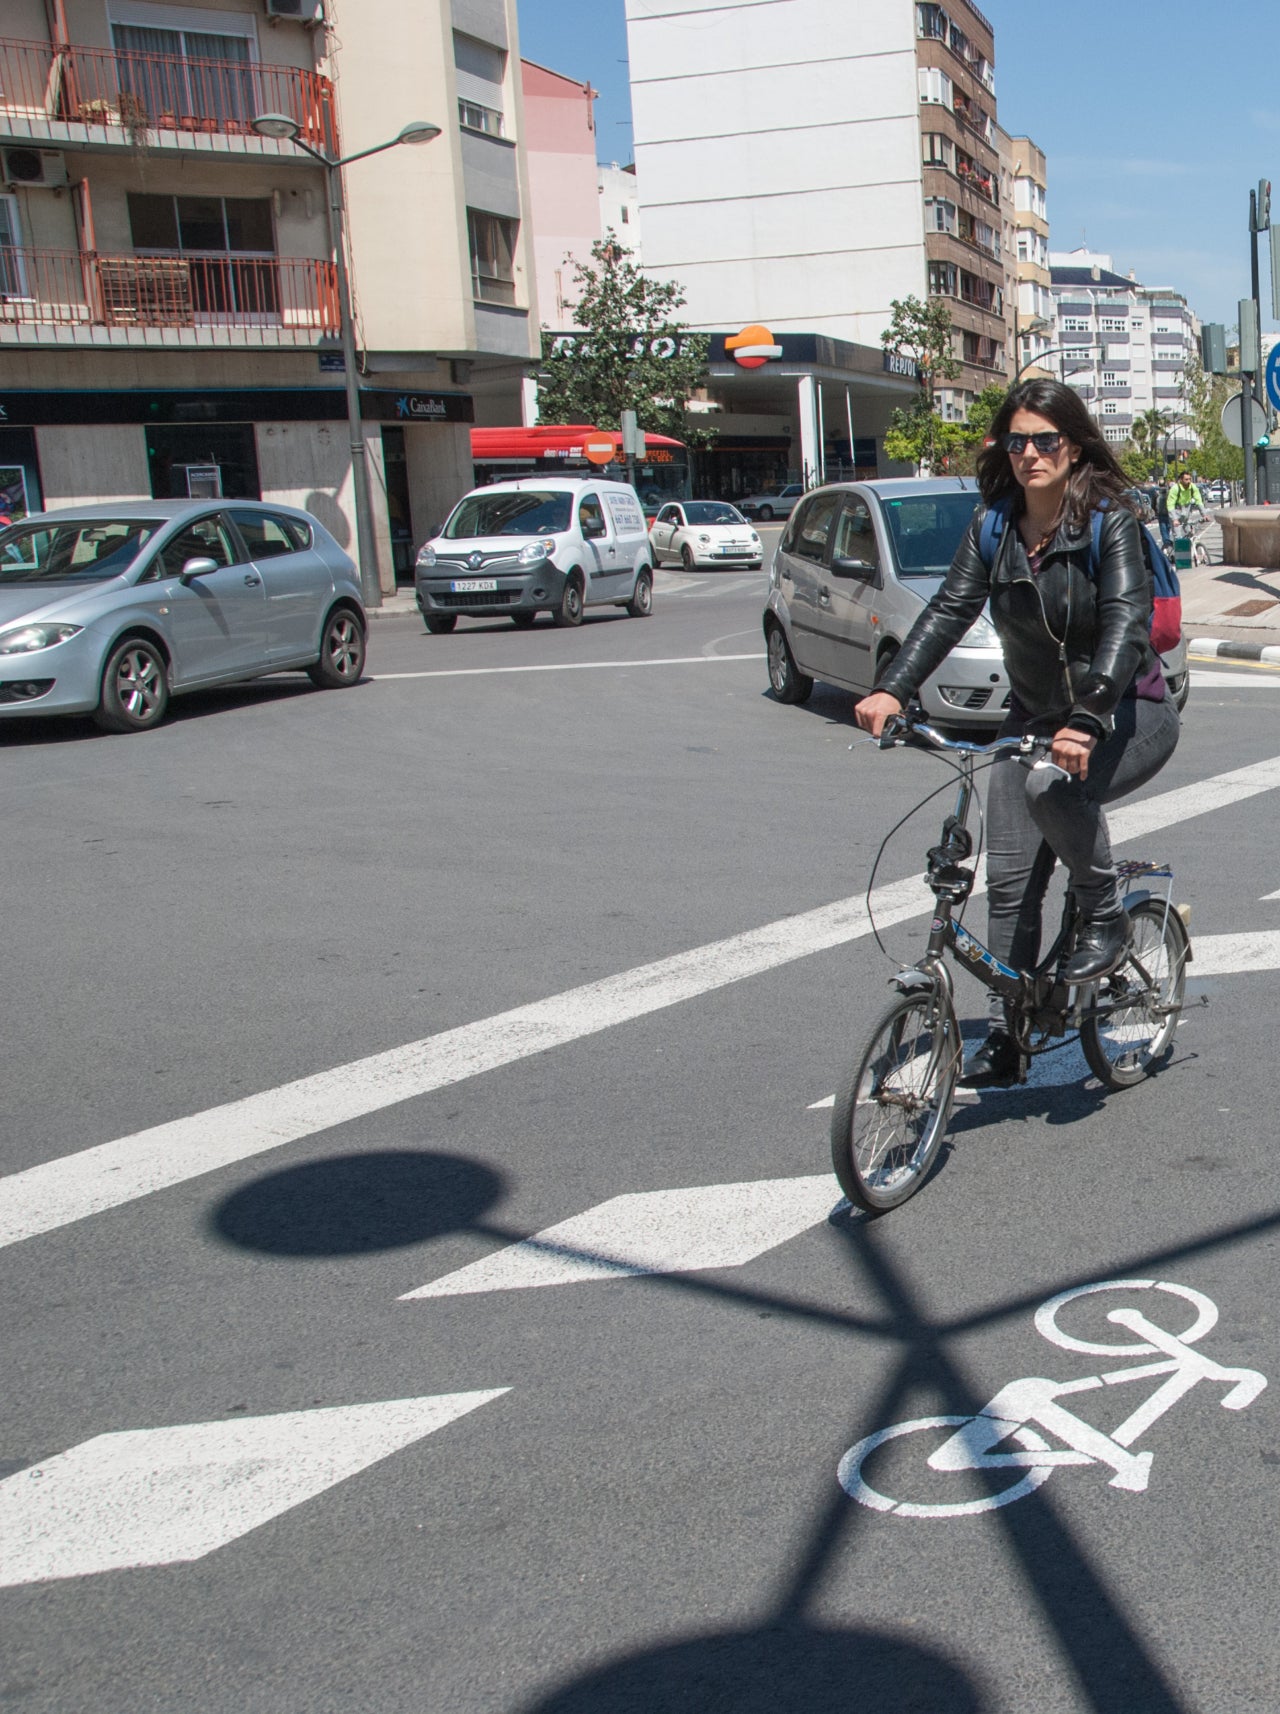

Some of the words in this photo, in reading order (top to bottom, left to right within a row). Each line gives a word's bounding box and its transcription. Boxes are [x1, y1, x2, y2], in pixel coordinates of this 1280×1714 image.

[890, 355, 916, 377] REPSOL
[410, 397, 447, 413] CaixaBank
[457, 582, 476, 590] 1227
